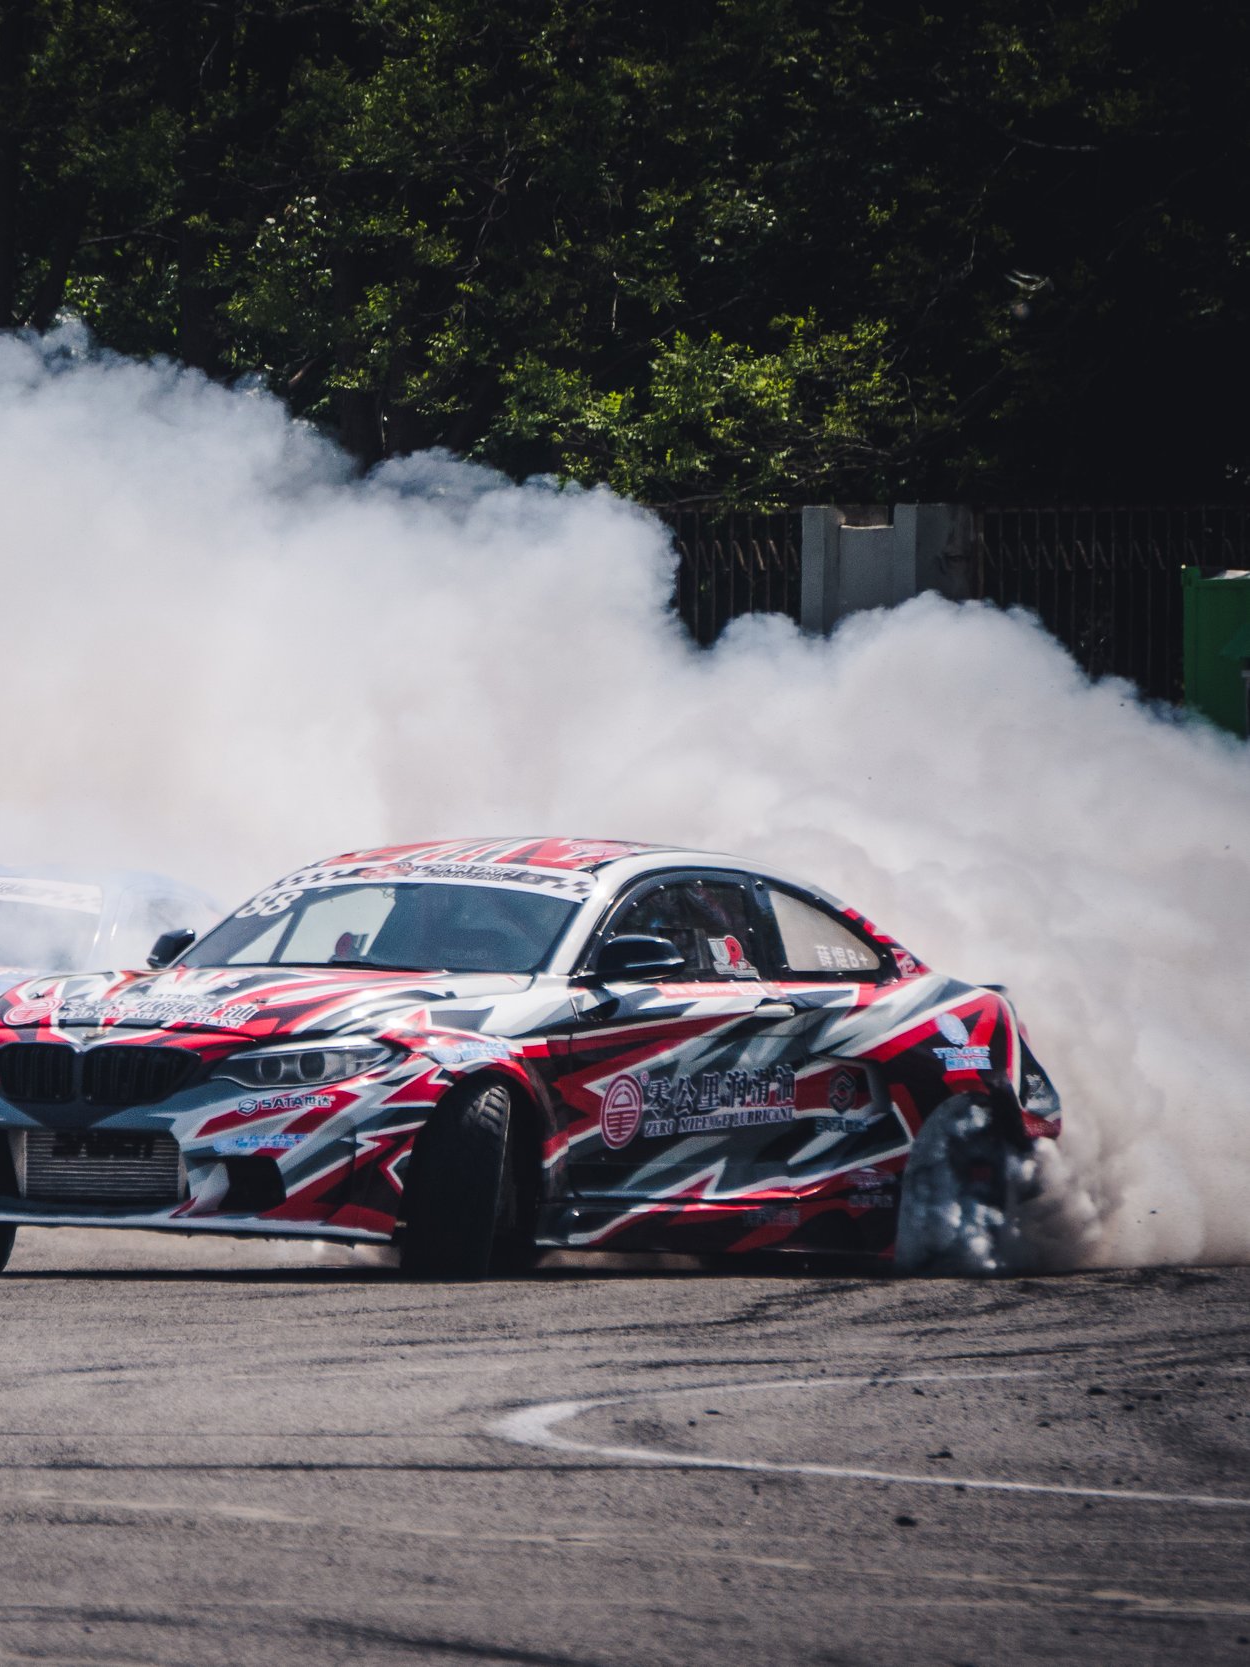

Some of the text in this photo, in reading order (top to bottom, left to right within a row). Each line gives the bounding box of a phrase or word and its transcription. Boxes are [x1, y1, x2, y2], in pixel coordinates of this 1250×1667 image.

[421, 863, 524, 878] CHINA DRIFT
[235, 890, 303, 919] 88
[648, 1064, 797, 1119] 零公里润滑油
[644, 1107, 796, 1137] ZERO MILEAGE LUBRICANT
